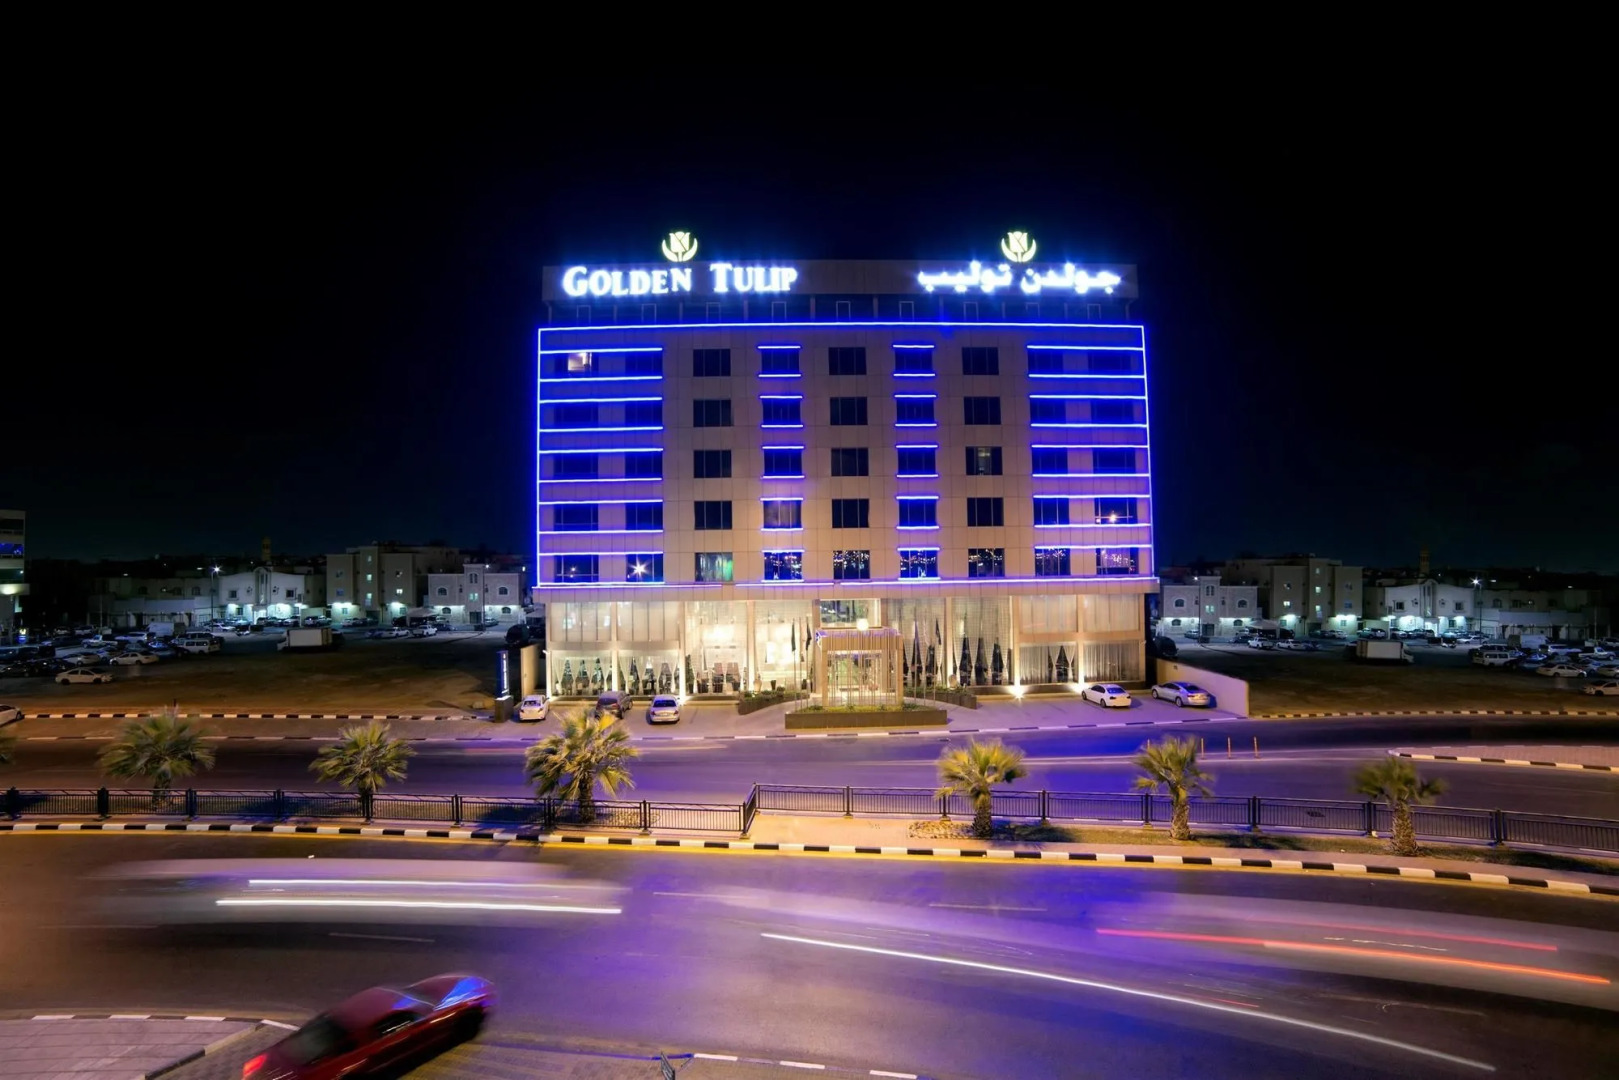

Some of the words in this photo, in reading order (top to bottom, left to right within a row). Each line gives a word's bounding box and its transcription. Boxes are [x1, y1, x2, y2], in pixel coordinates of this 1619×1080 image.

[562, 265, 692, 297] GOLDEN
[710, 262, 798, 293] TULIP
[918, 260, 1012, 294] توليب
